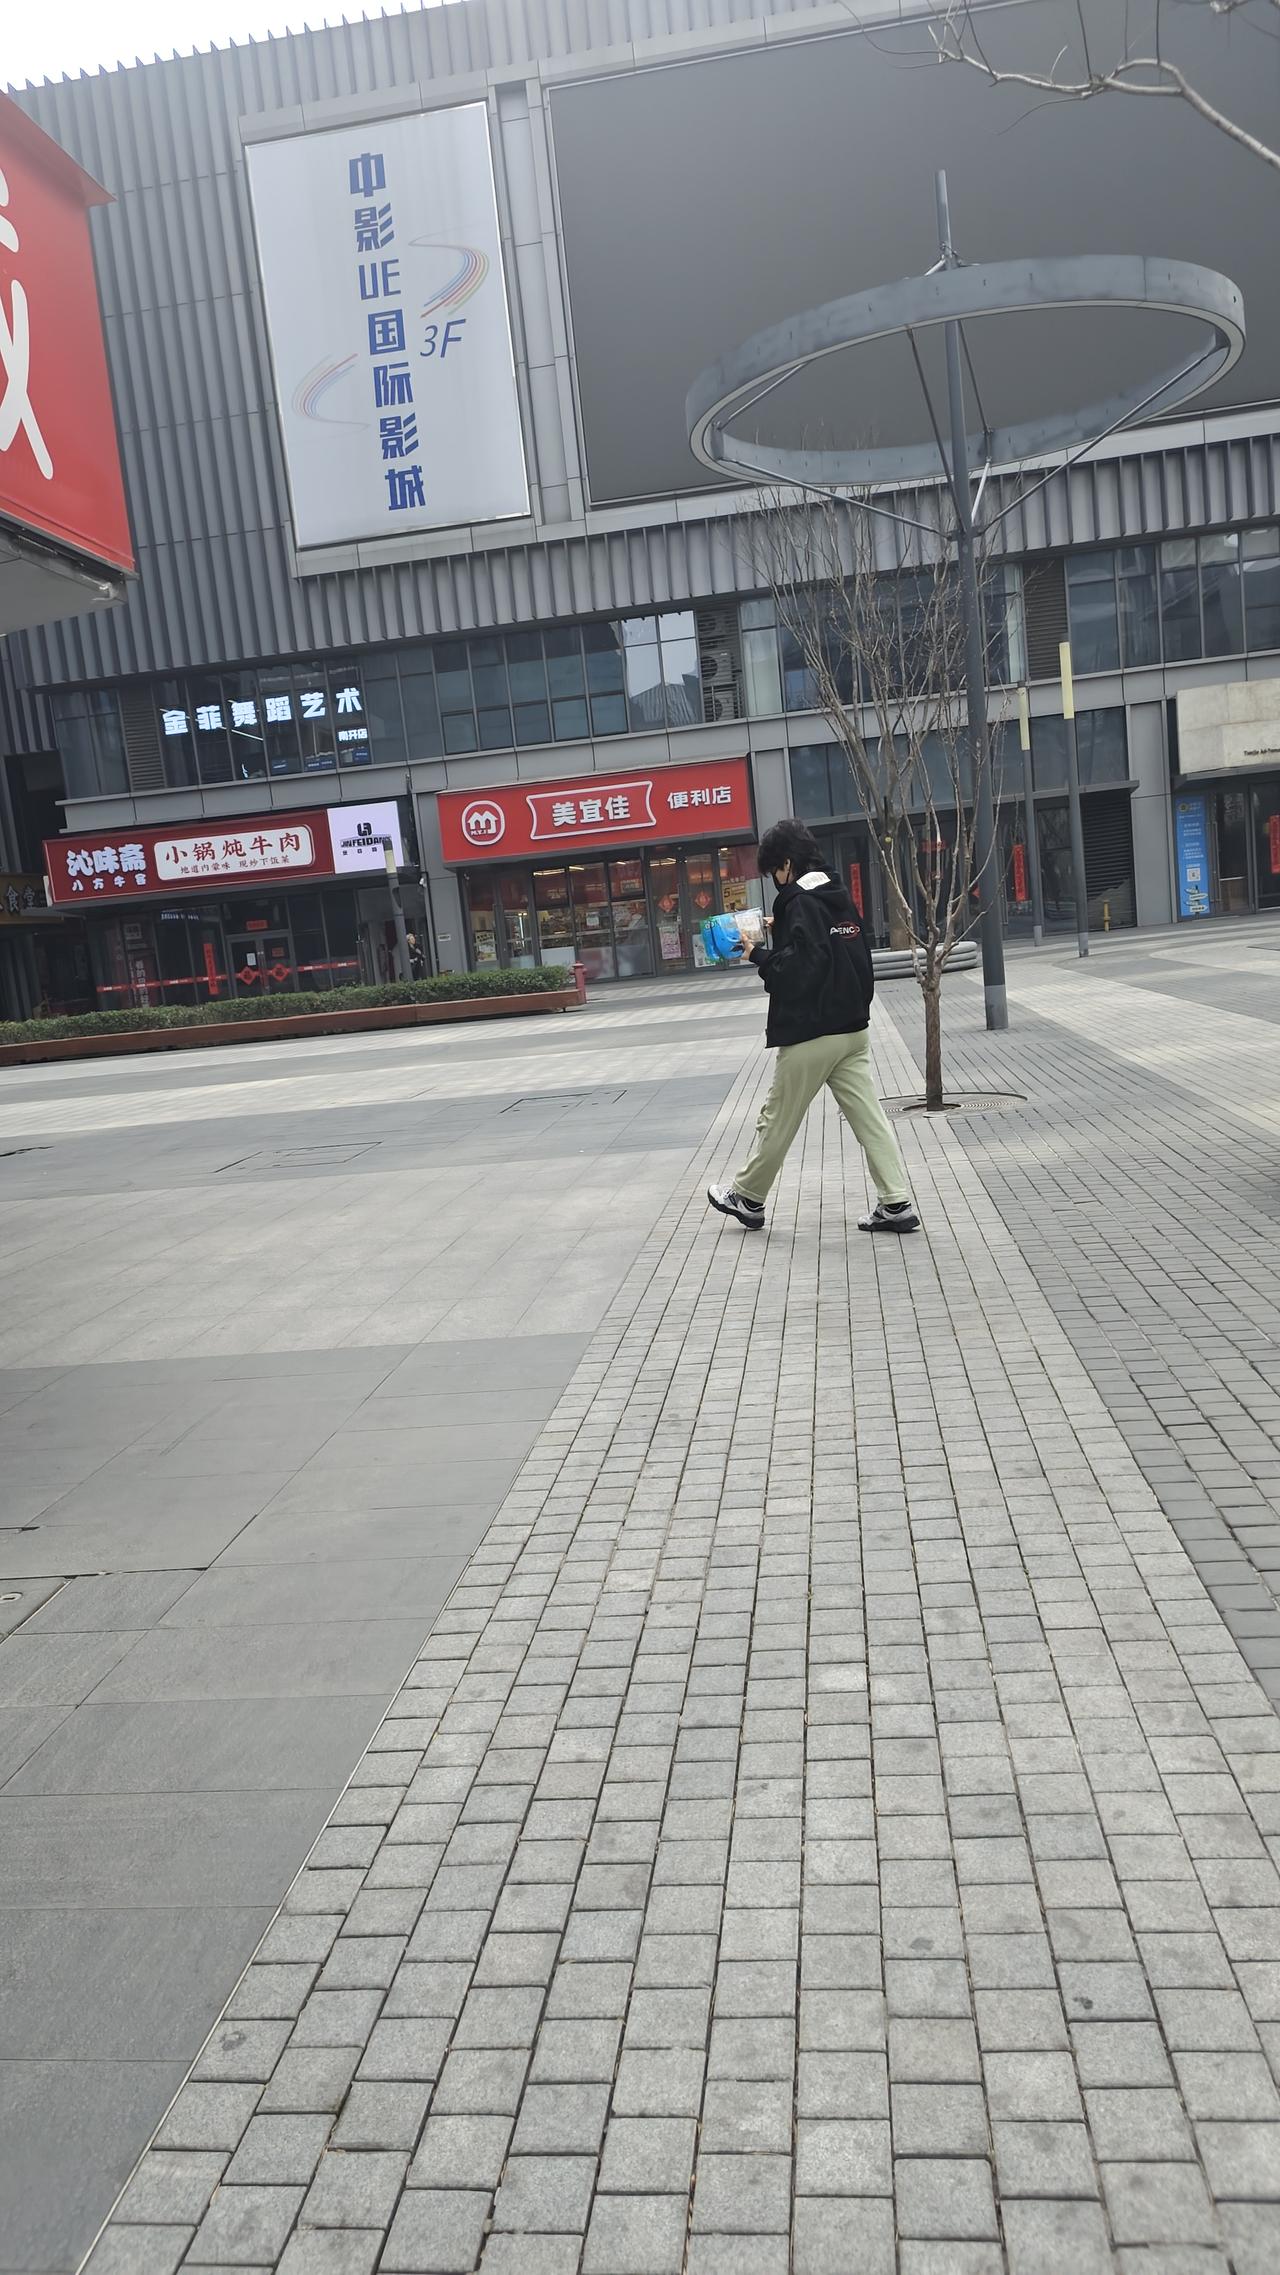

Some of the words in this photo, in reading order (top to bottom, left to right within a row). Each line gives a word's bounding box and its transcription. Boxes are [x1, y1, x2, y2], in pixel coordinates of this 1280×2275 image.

[349, 152, 426, 511] 中影UE国际影城
[420, 318, 466, 359] 3F
[162, 687, 362, 736] 金菲舞蹈艺术
[552, 795, 631, 827] 美宜佳
[667, 786, 732, 810] 便利店
[66, 843, 146, 876] 沁味斋
[165, 832, 300, 864] 小锅炖牛肉
[180, 861, 231, 874] 地道内蒙味
[239, 855, 291, 868] 现炒下饭菜
